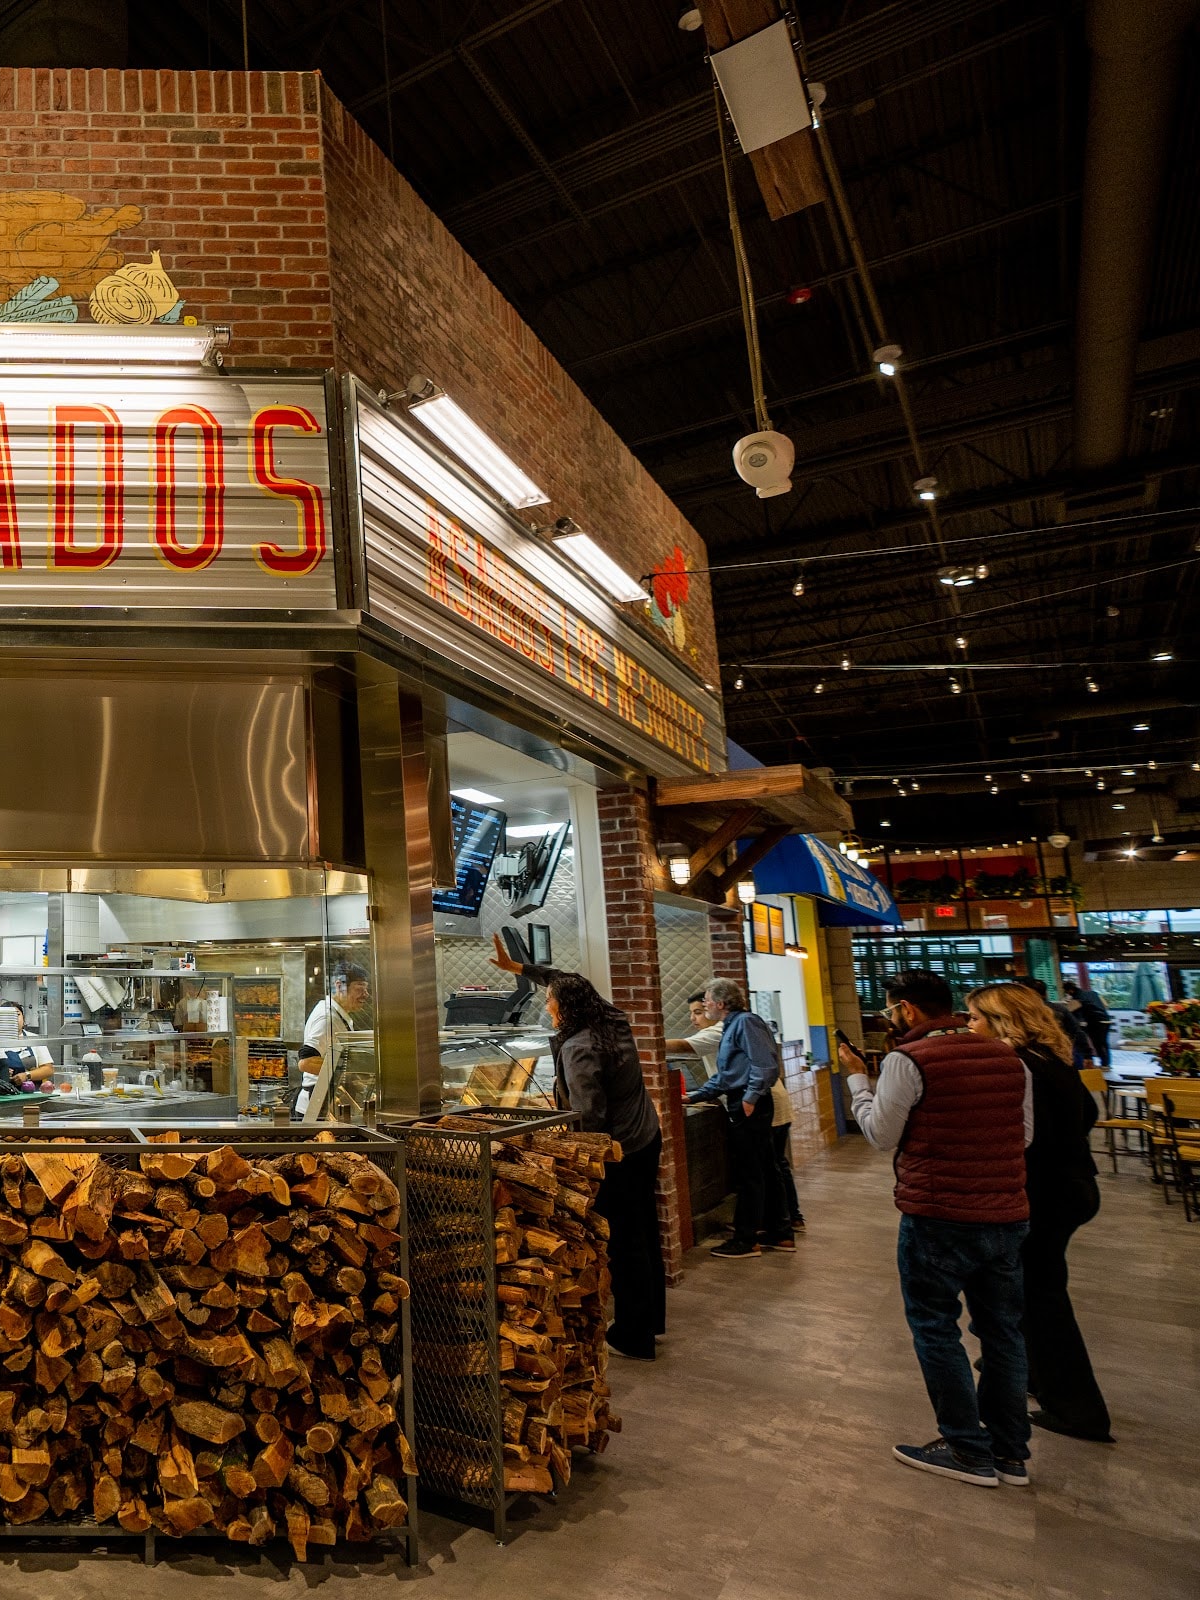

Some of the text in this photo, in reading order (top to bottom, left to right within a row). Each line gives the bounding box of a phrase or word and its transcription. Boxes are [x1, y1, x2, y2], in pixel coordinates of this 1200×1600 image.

[424, 496, 710, 772] ASADOS LOS MESQUITES
